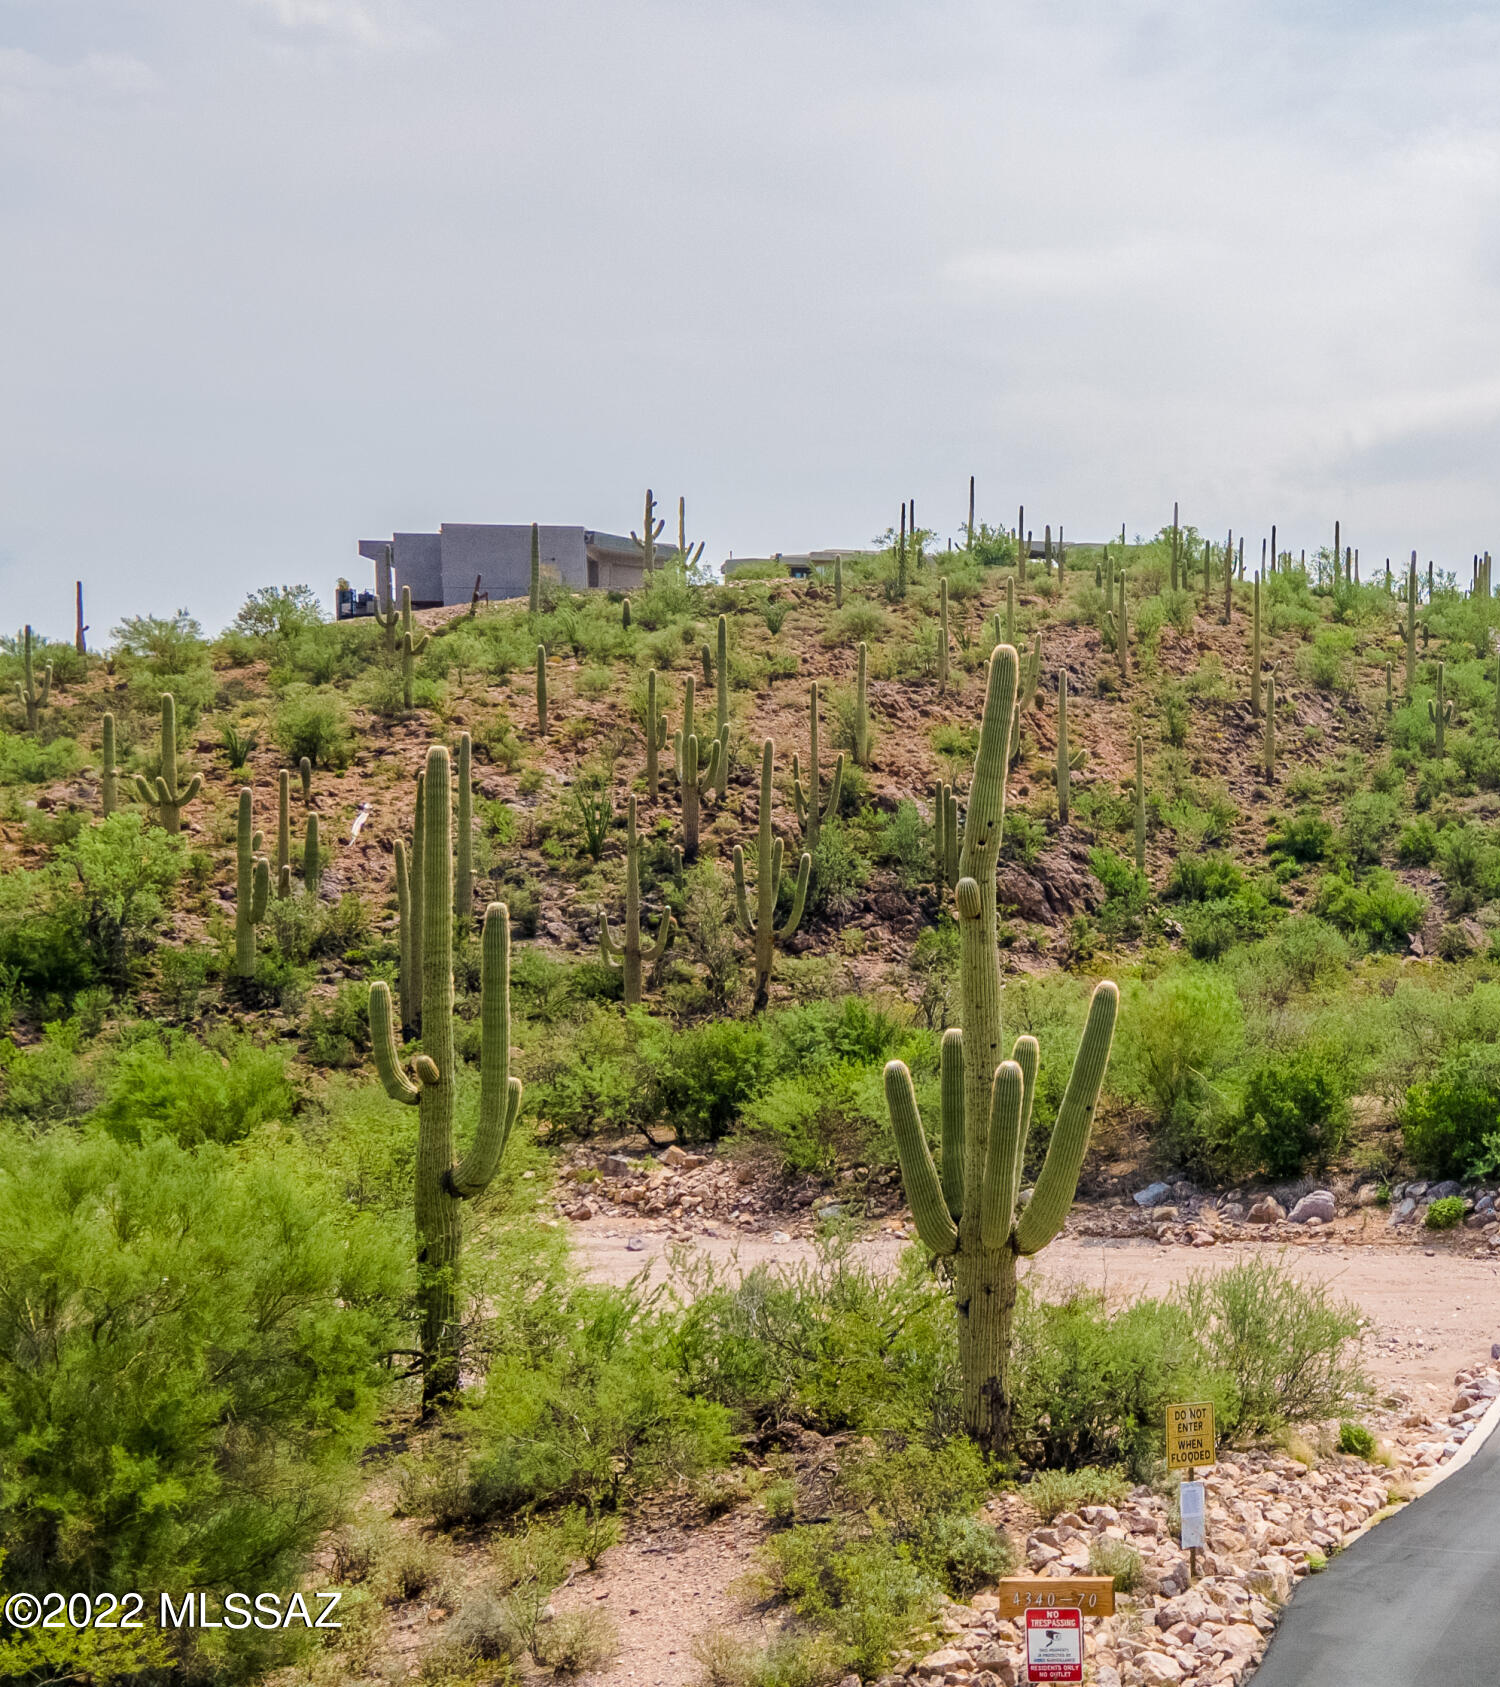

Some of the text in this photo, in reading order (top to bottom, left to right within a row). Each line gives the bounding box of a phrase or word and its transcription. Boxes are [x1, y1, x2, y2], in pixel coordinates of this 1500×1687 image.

[1174, 1408, 1207, 1421] DO NOT
[1178, 1421, 1203, 1432] ENTER
[1178, 1439, 1203, 1449] WHEN
[1171, 1450, 1211, 1463] FLOODED
[1046, 1610, 1060, 1619] NO
[1031, 1619, 1076, 1628] TRESPASSING
